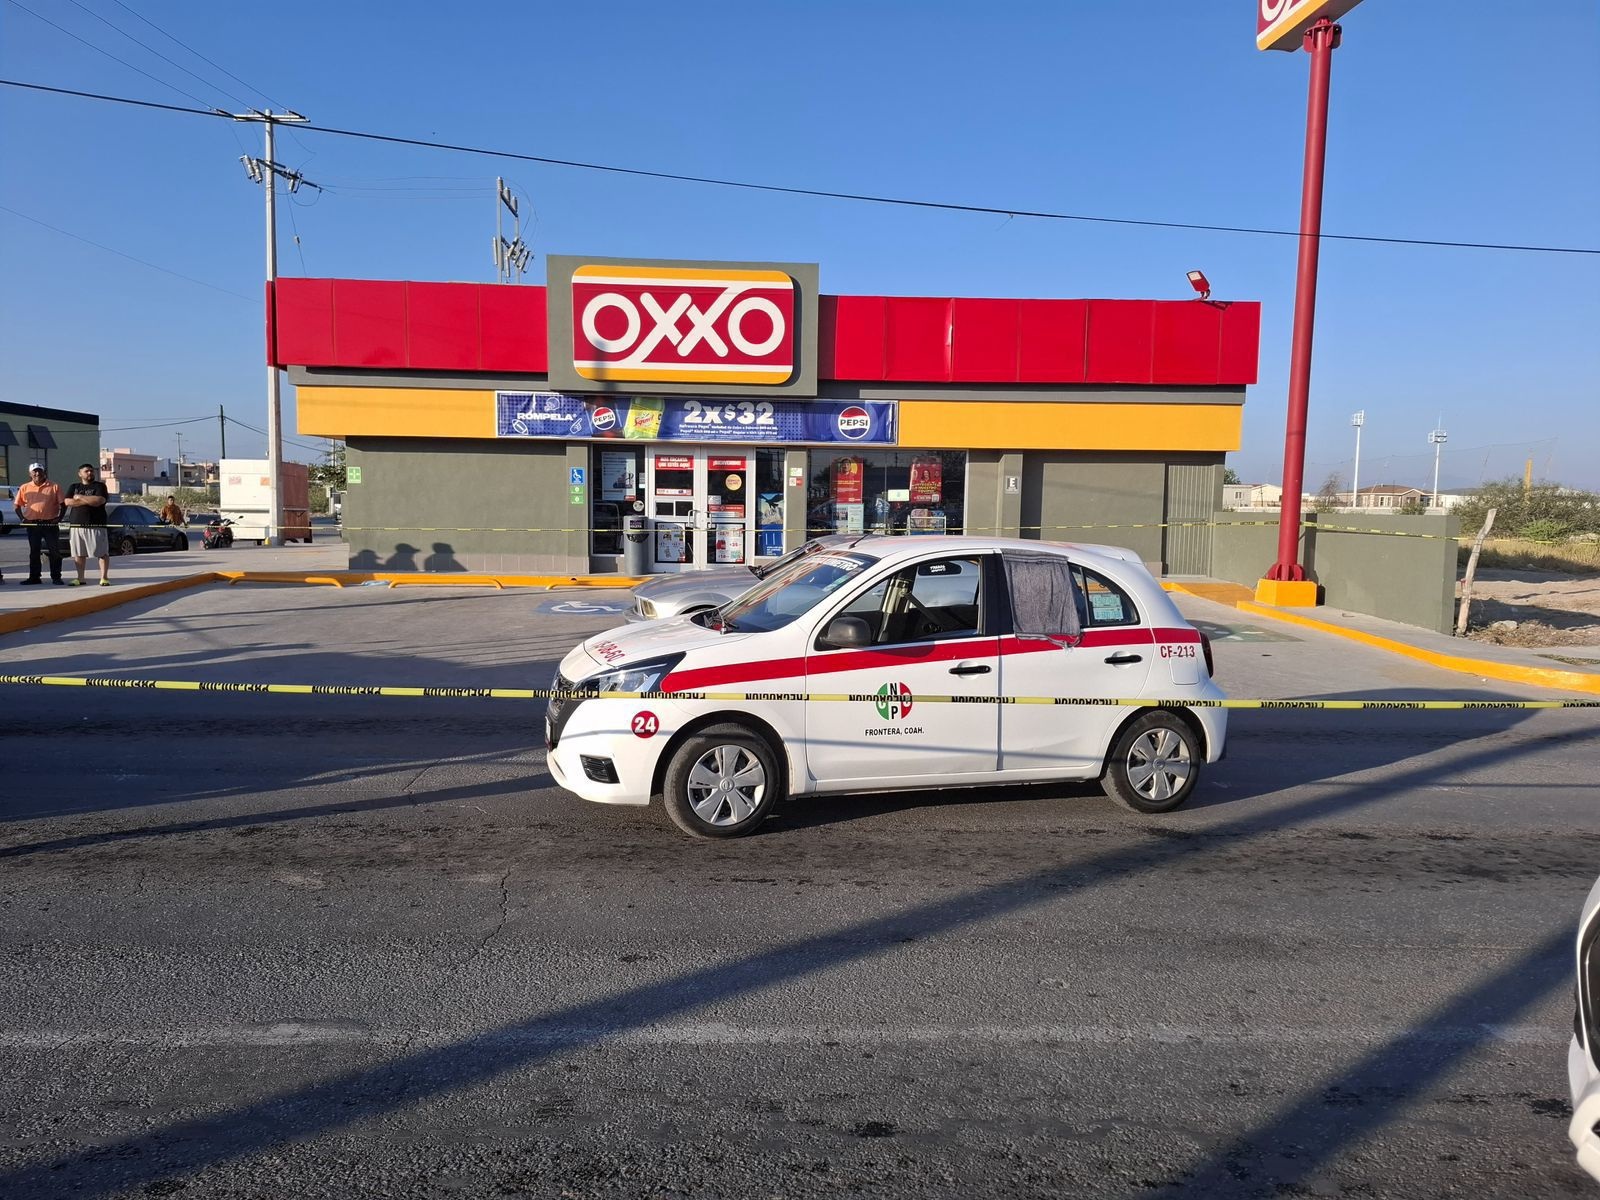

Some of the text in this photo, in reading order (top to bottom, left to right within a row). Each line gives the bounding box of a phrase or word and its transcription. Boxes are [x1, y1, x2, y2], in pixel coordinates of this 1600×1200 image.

[582, 287, 785, 361] OXXO
[593, 414, 614, 423] PEPSI
[840, 419, 868, 427] PEPSI
[1009, 477, 1016, 487] E
[1160, 645, 1196, 658] CF-213
[634, 716, 656, 733] 24
[865, 726, 924, 736] FRONTERA, COAH.
